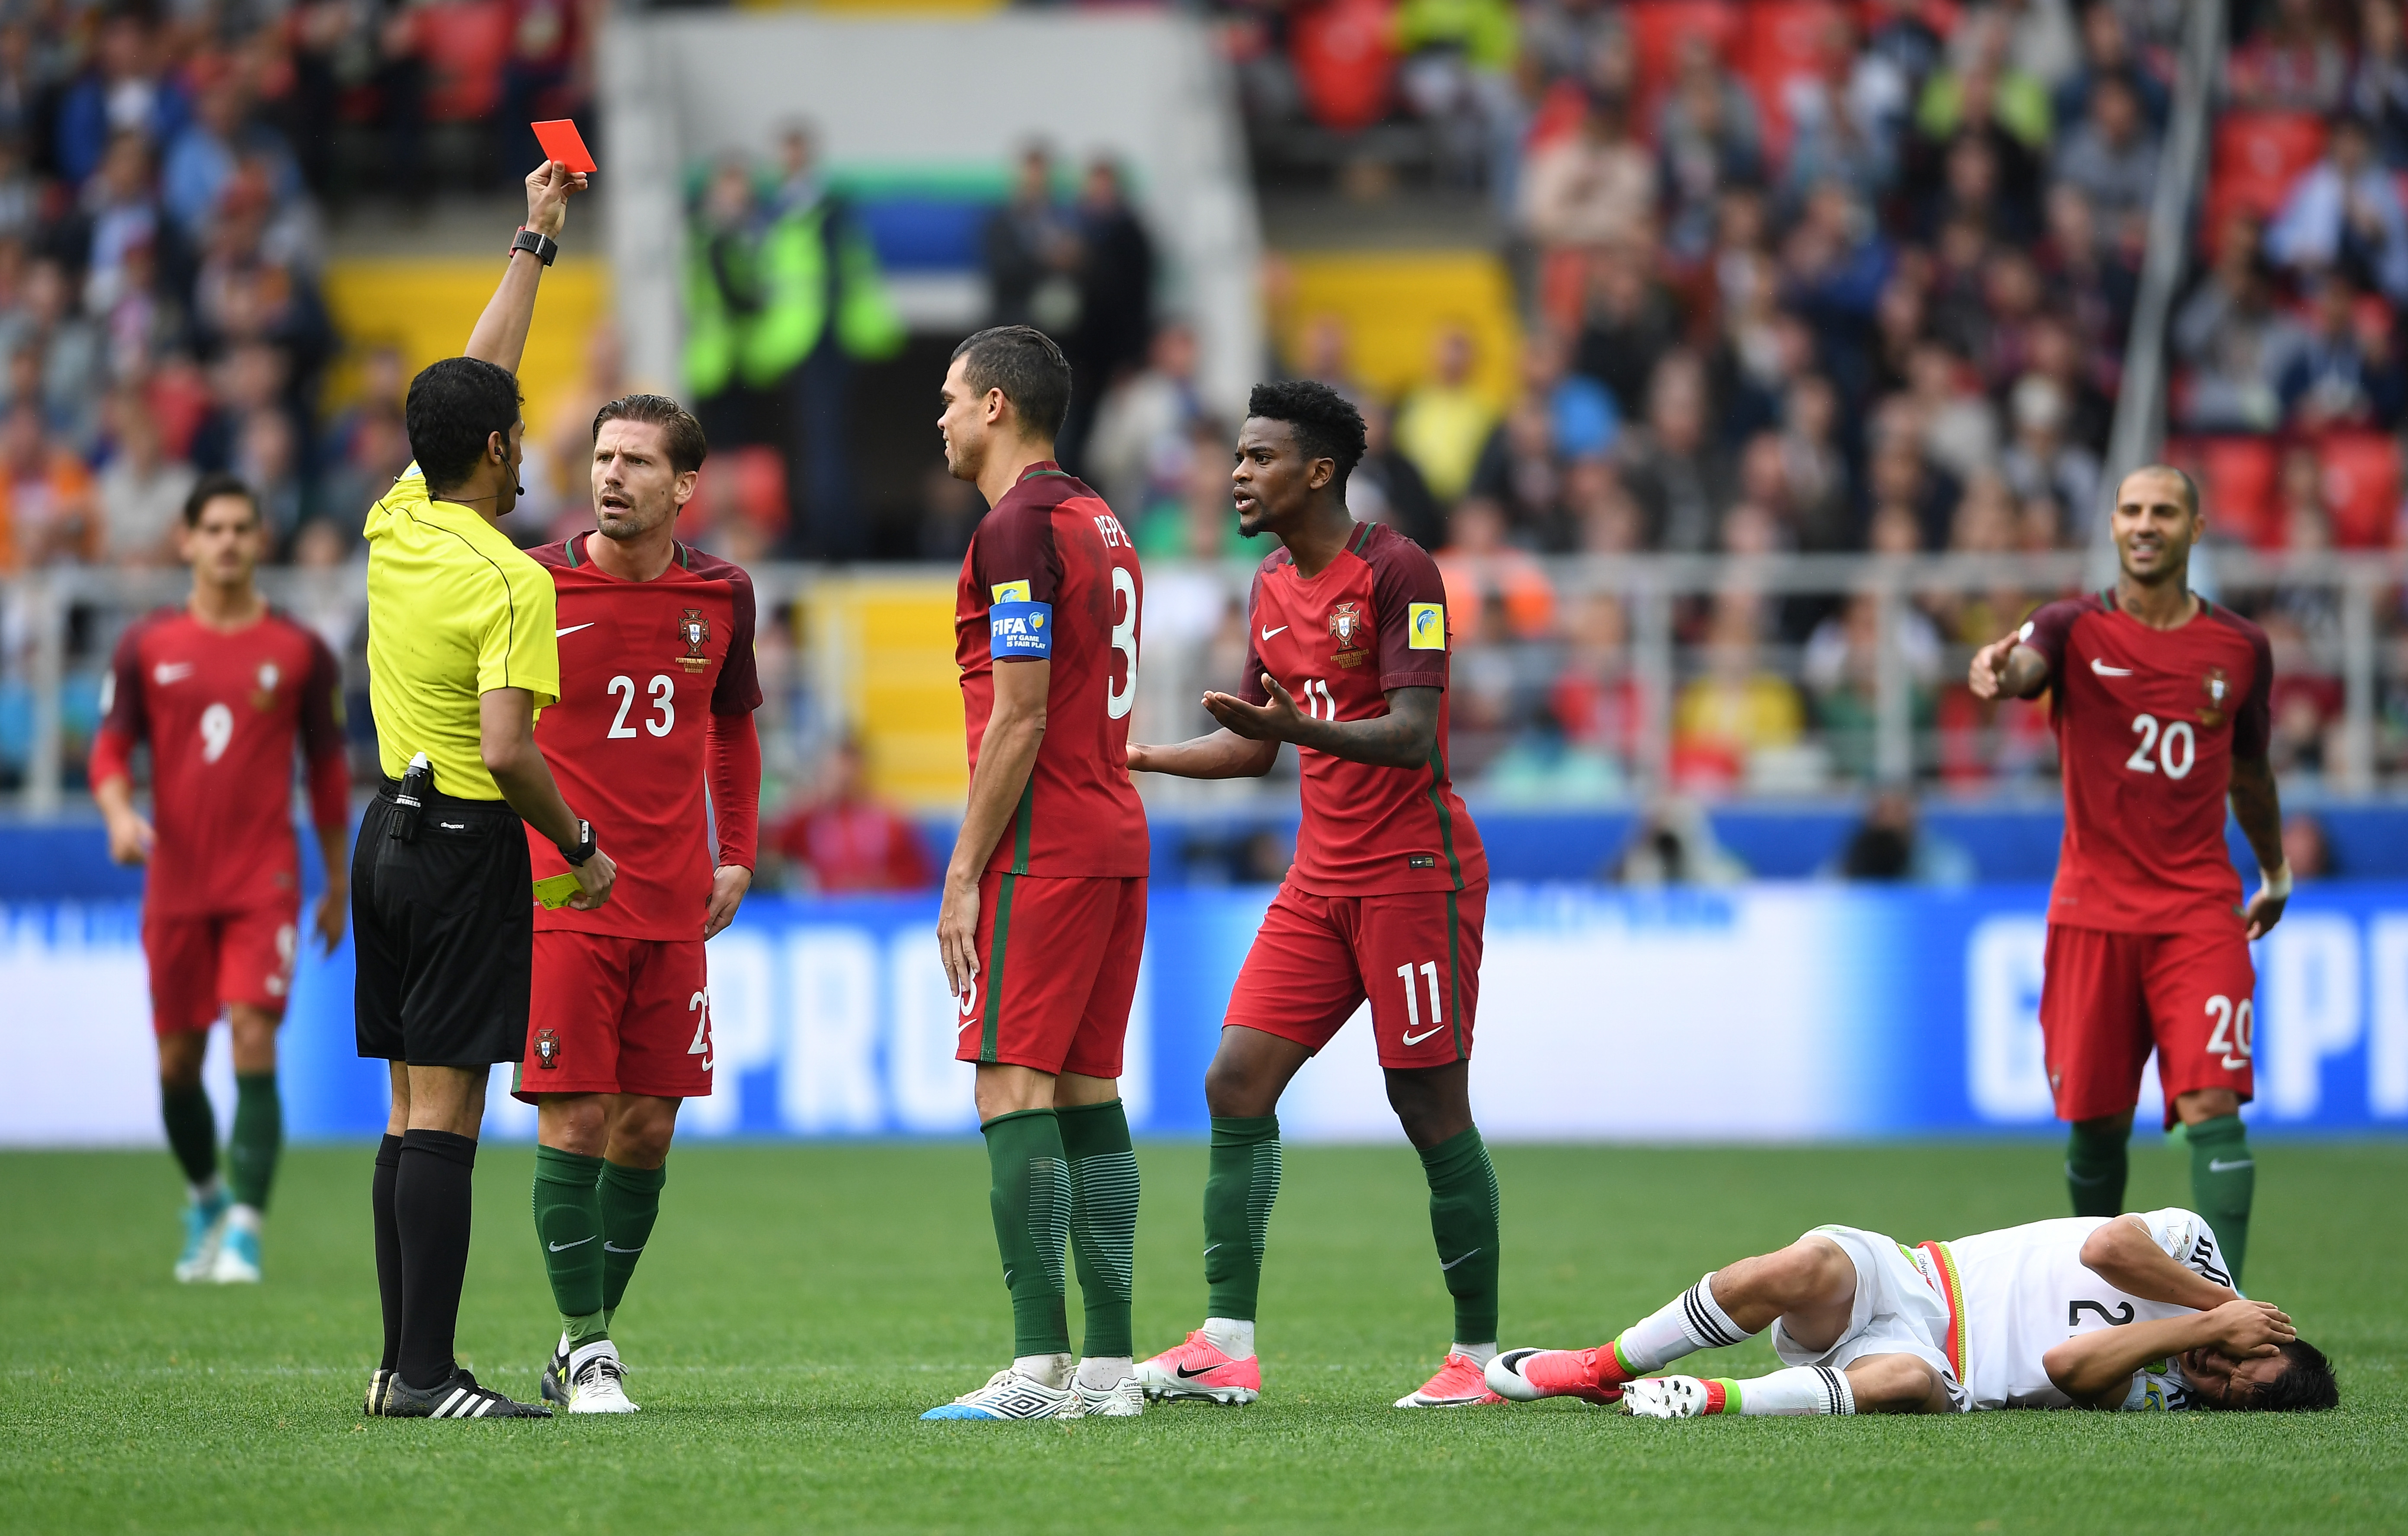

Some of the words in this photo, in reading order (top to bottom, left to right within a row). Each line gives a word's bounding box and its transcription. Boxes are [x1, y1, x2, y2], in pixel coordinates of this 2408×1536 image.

[1093, 515, 1132, 549] PEPE
[993, 617, 1027, 638] FIFA
[1108, 567, 1137, 720] 3
[607, 674, 675, 739] 23
[1304, 678, 1335, 722] 11
[199, 702, 235, 765] 9
[2126, 713, 2195, 780] 20
[1397, 960, 1442, 1026] 11
[2204, 994, 2254, 1057] 20
[1917, 1254, 1928, 1276] Calvin
[2069, 1300, 2135, 1337] 2
